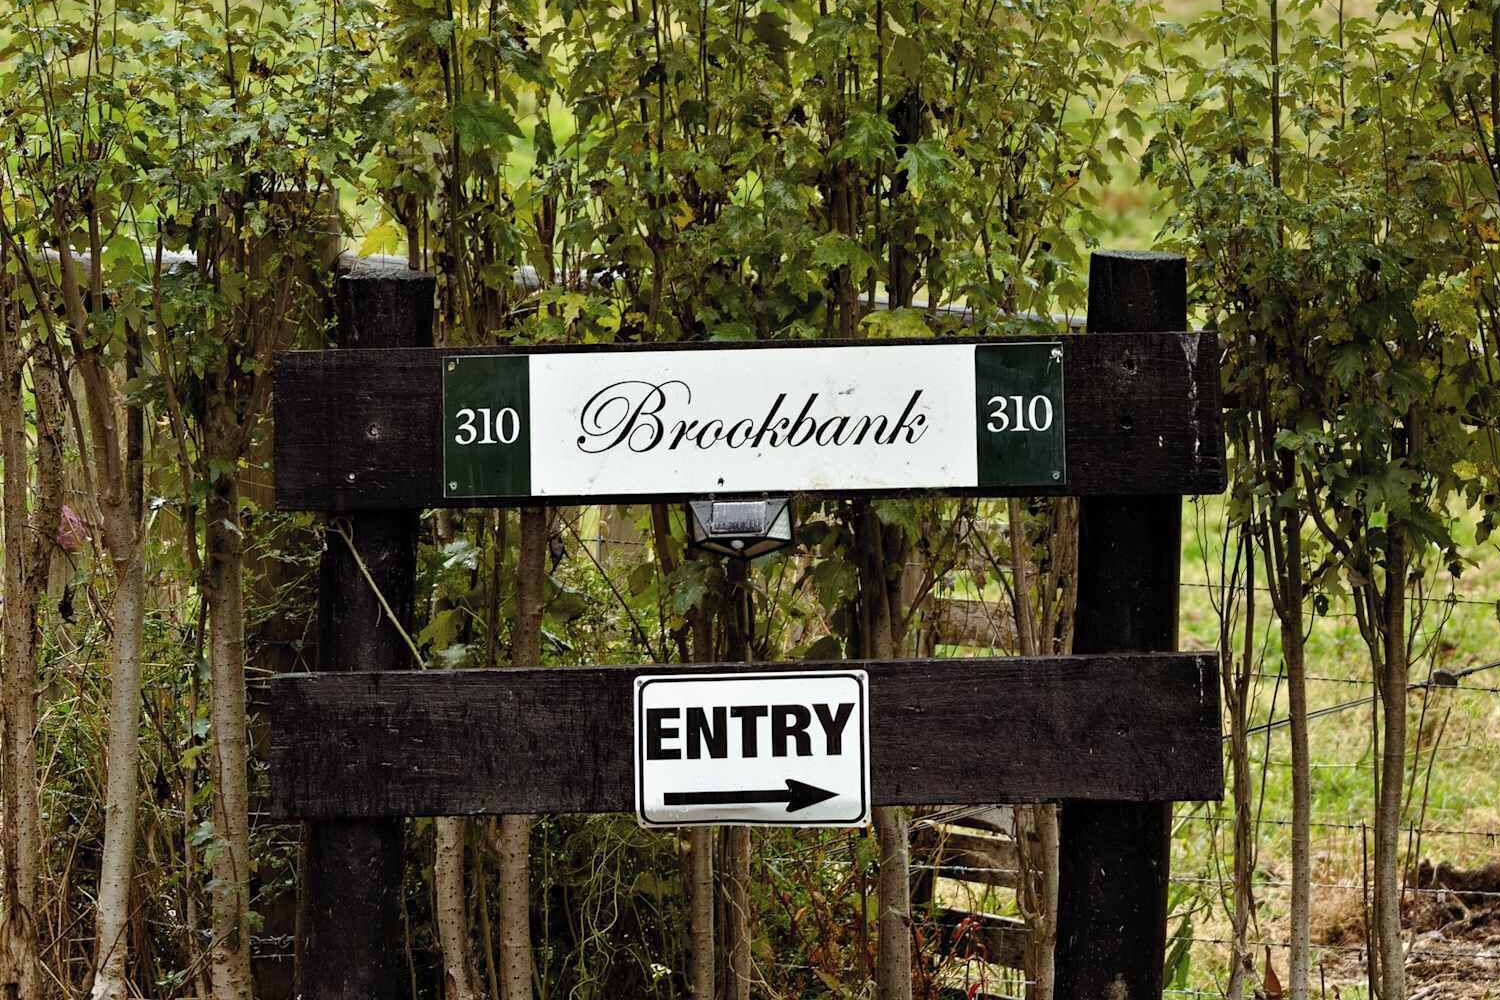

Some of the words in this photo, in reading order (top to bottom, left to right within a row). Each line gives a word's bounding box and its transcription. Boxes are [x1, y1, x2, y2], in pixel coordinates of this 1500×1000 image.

[454, 407, 520, 445] 310
[577, 379, 929, 454] Brookbank
[987, 394, 1053, 433] 310
[646, 702, 856, 761] ENTRY
